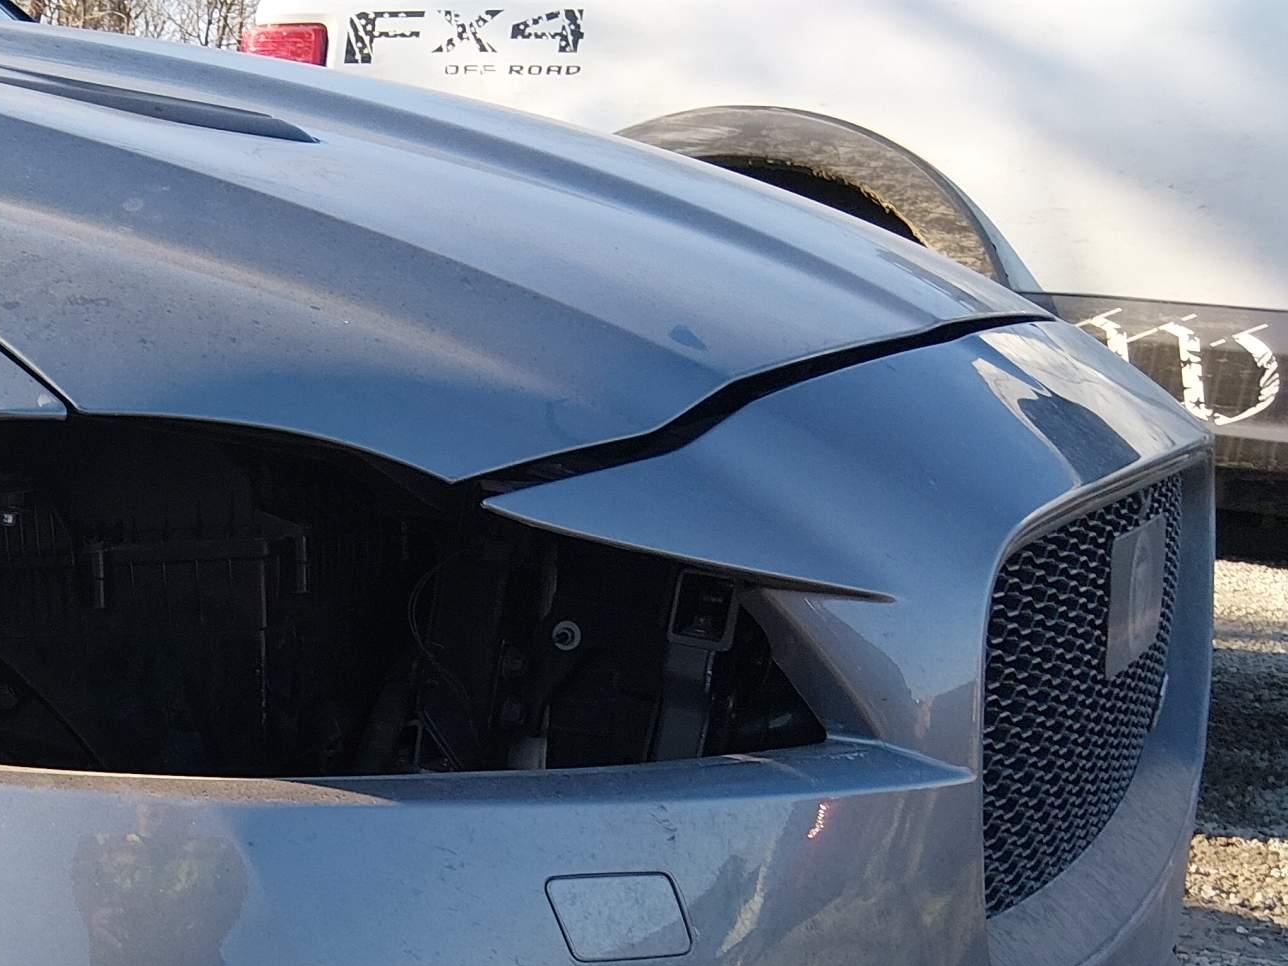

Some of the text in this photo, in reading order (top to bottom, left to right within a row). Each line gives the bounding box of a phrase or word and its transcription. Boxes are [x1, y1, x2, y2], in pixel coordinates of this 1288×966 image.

[345, 9, 584, 64] FX4
[445, 65, 581, 75] OFF ROAD
